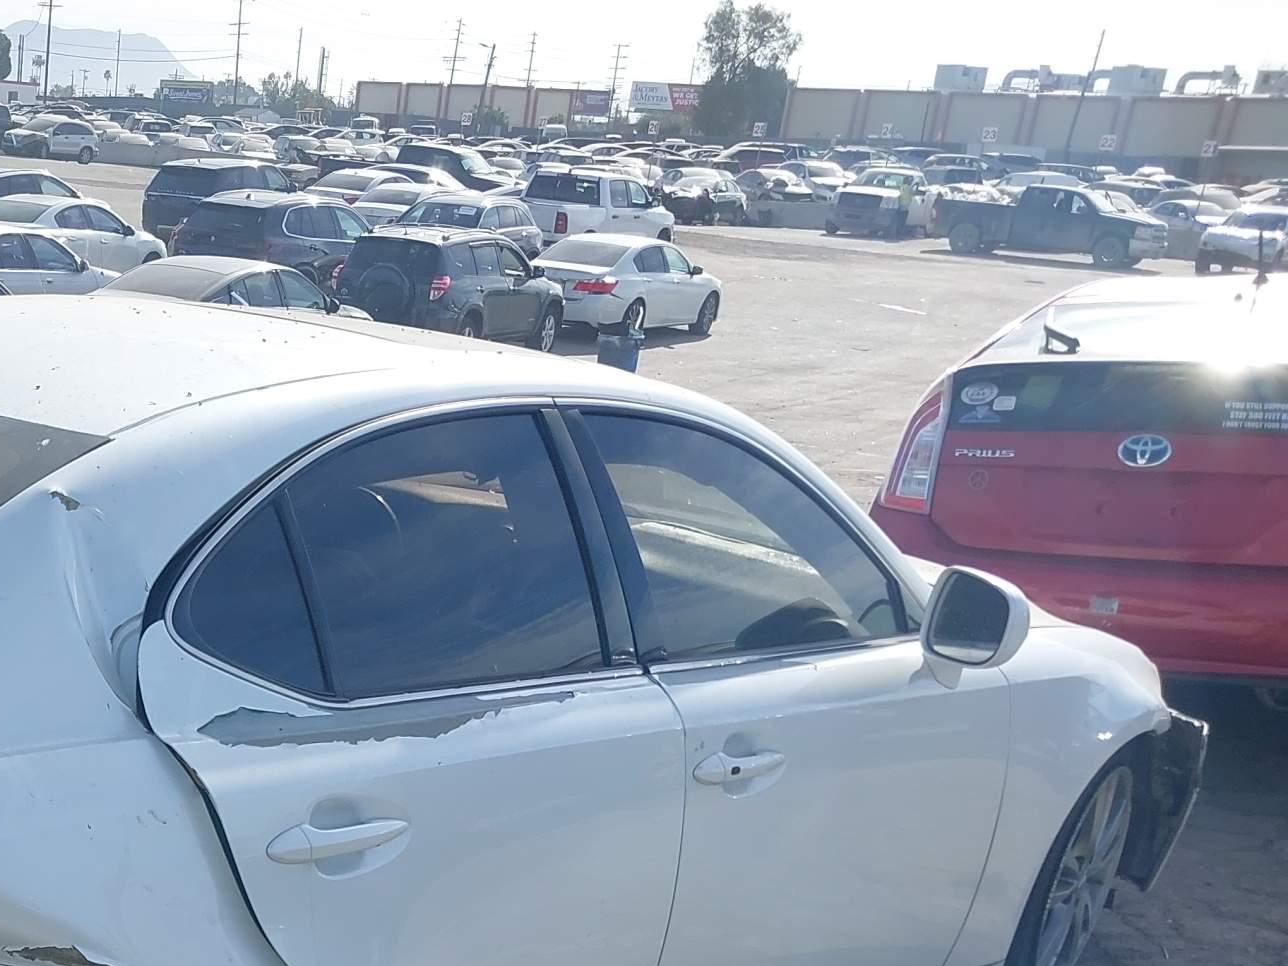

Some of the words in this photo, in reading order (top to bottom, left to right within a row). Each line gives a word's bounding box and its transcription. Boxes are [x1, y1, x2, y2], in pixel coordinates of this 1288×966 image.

[983, 129, 998, 140] 23
[1100, 136, 1116, 148] 22
[954, 448, 1016, 458] PRIUS
